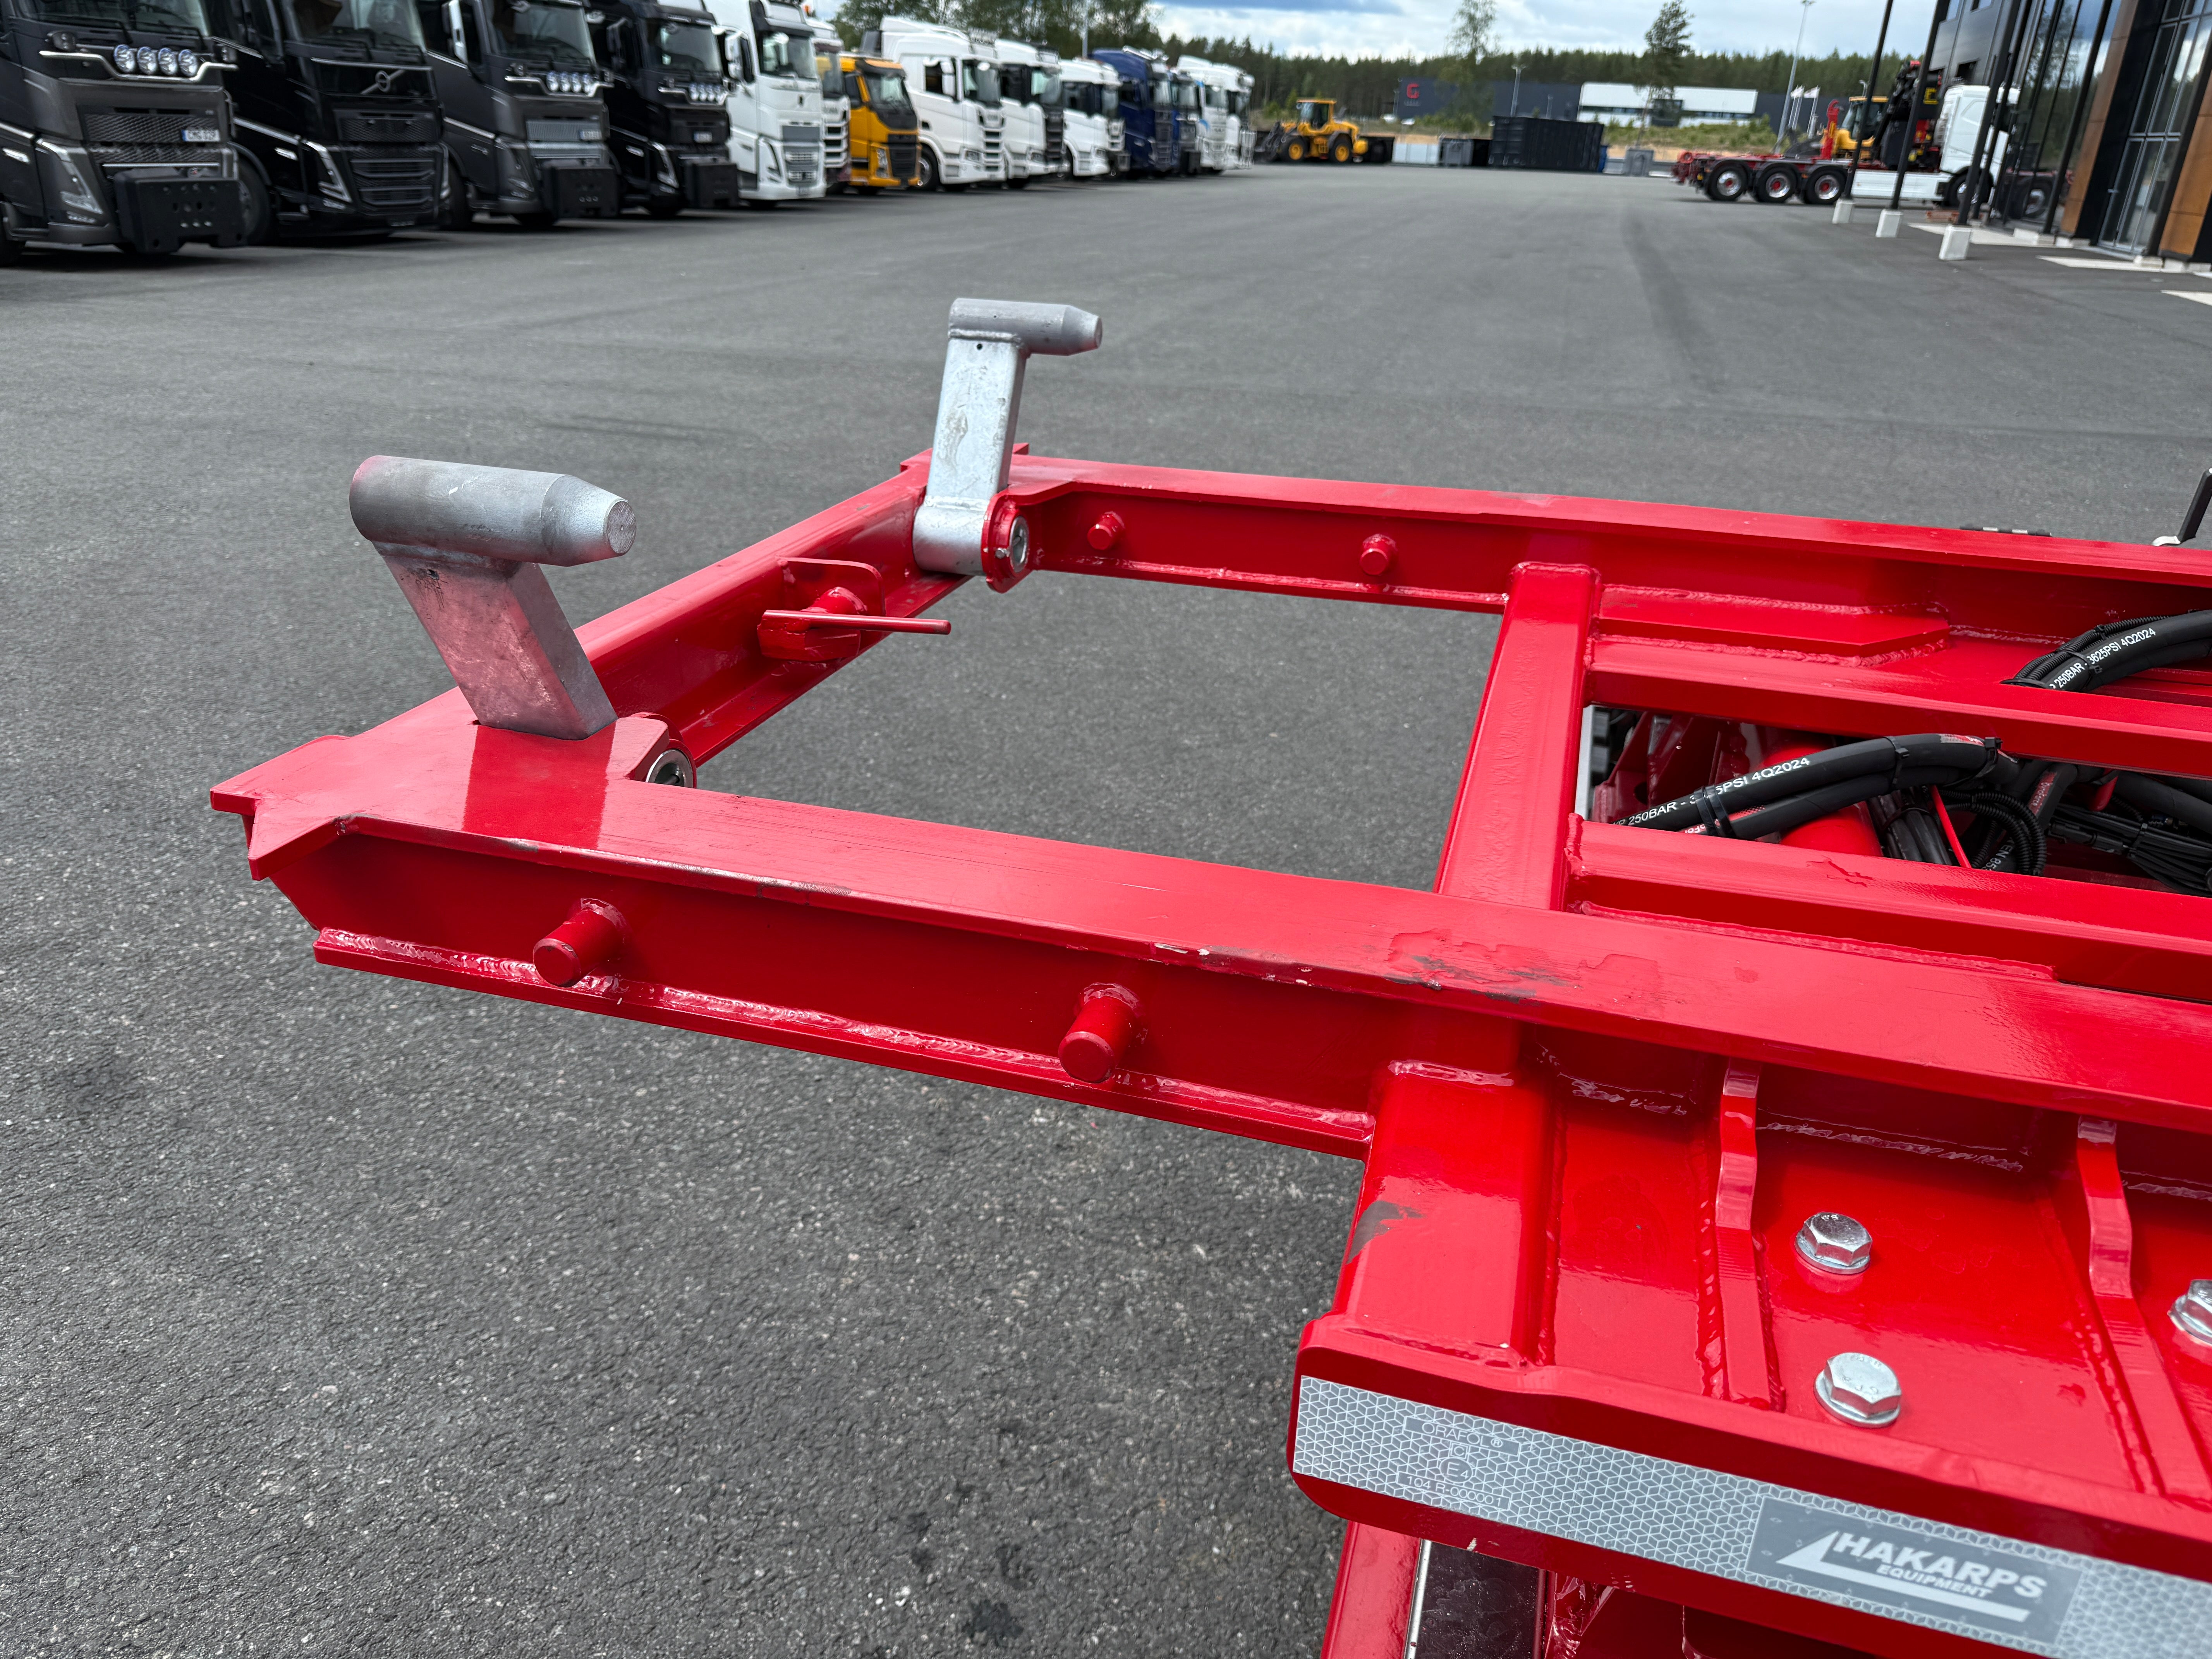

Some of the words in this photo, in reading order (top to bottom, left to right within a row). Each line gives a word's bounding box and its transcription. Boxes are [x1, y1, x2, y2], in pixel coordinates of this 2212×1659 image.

[2054, 662, 2085, 689] 250BAR
[2086, 641, 2121, 665] 3625PSI
[2121, 627, 2156, 647] 4Q2024
[1628, 801, 1677, 826] 250BAR
[1752, 757, 1810, 780] 4Q2024
[1407, 1475, 1431, 1490] 104
[1832, 1532, 2047, 1598] HAKARPS
[1876, 1564, 1994, 1599] EQUIPMENT
